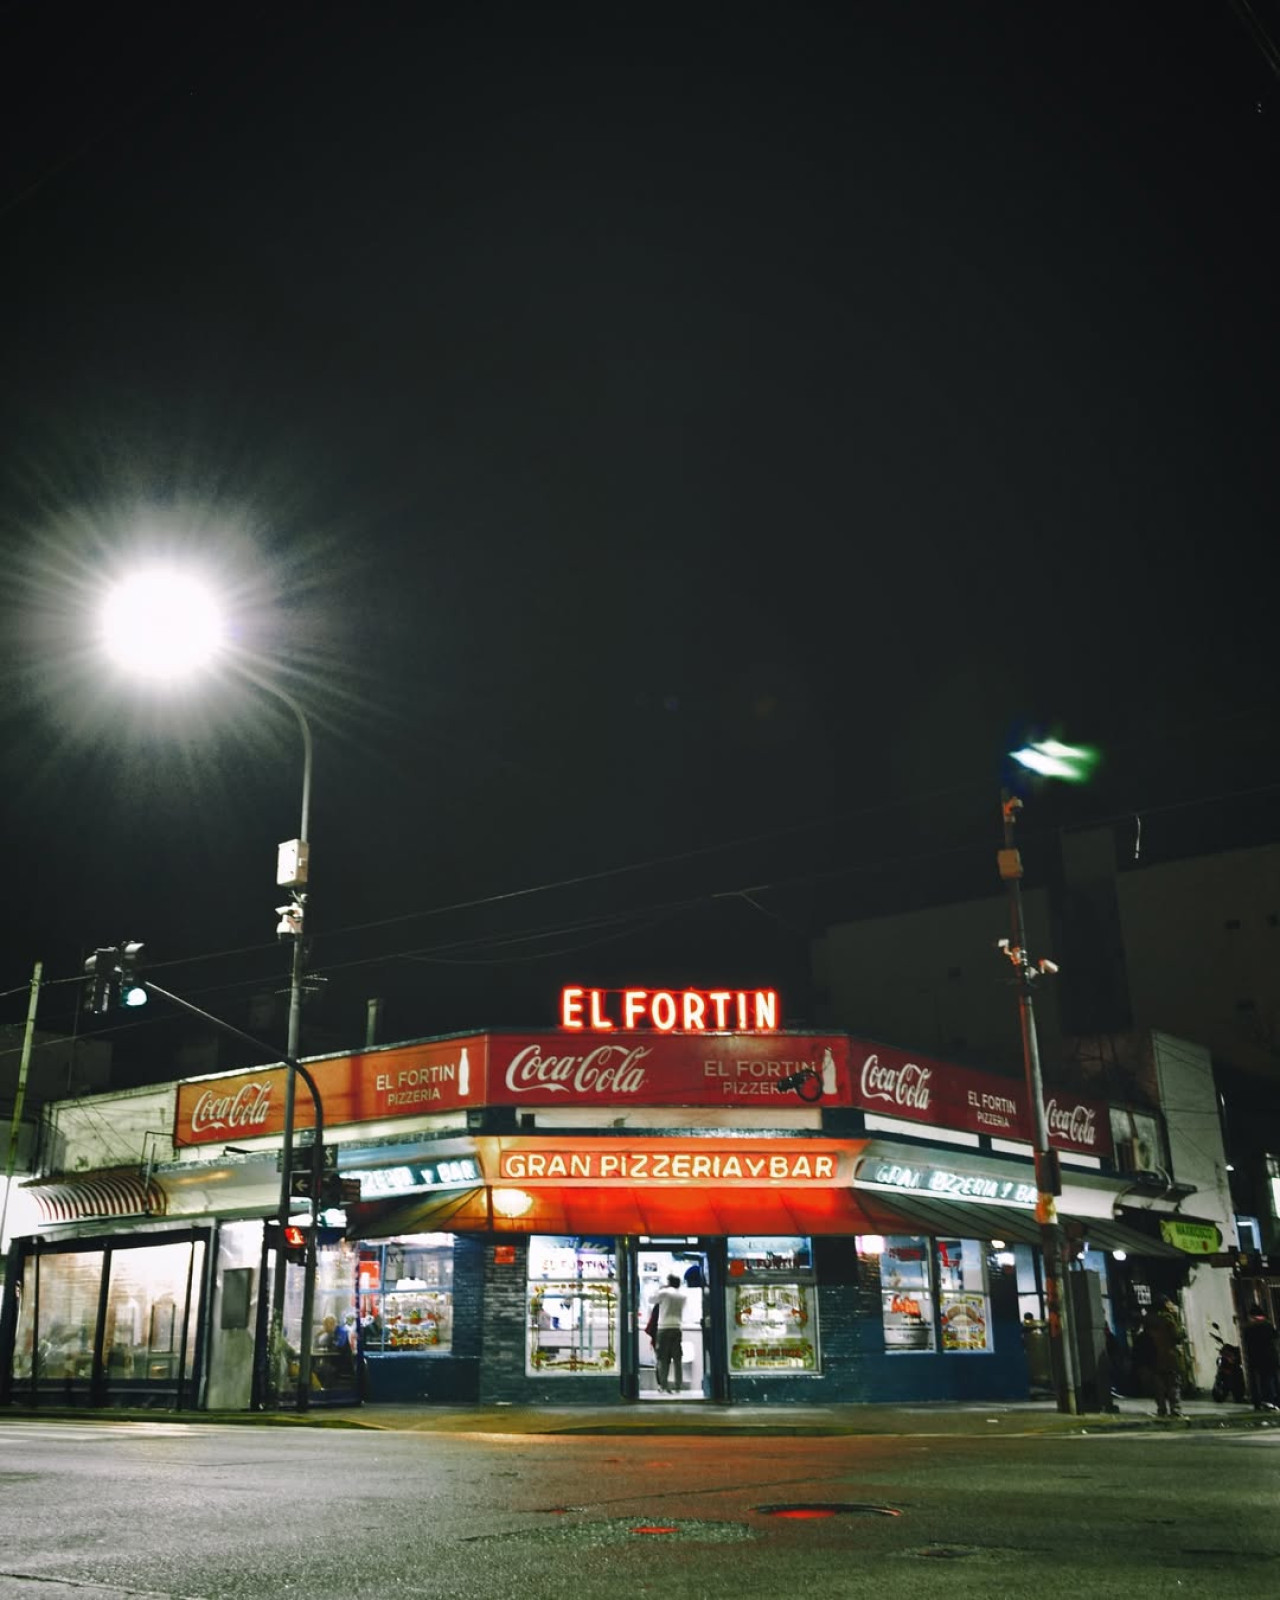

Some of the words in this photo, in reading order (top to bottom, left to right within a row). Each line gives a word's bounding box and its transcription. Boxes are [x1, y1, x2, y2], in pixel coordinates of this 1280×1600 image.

[561, 987, 614, 1031] EL
[624, 989, 779, 1031] FORTIN
[376, 1074, 394, 1091] EL
[398, 1063, 455, 1086] FORTIN
[505, 1044, 653, 1093] Coca-Cola
[704, 1061, 730, 1077] EL
[723, 1081, 798, 1095] PIZZER
[861, 1054, 932, 1110] Coca-Cola
[191, 1080, 274, 1133] Coca-Cola
[387, 1087, 442, 1105] PIZZERIA
[967, 1090, 980, 1107] EL
[981, 1092, 1017, 1115] FORTIN
[976, 1110, 1010, 1128] PIZZERIA
[1045, 1098, 1096, 1145] Coca-Cola
[505, 1154, 592, 1178] GRAN
[600, 1154, 743, 1178] PIZZERIA
[769, 1155, 833, 1178] BAR
[1014, 1185, 1038, 1203] BA
